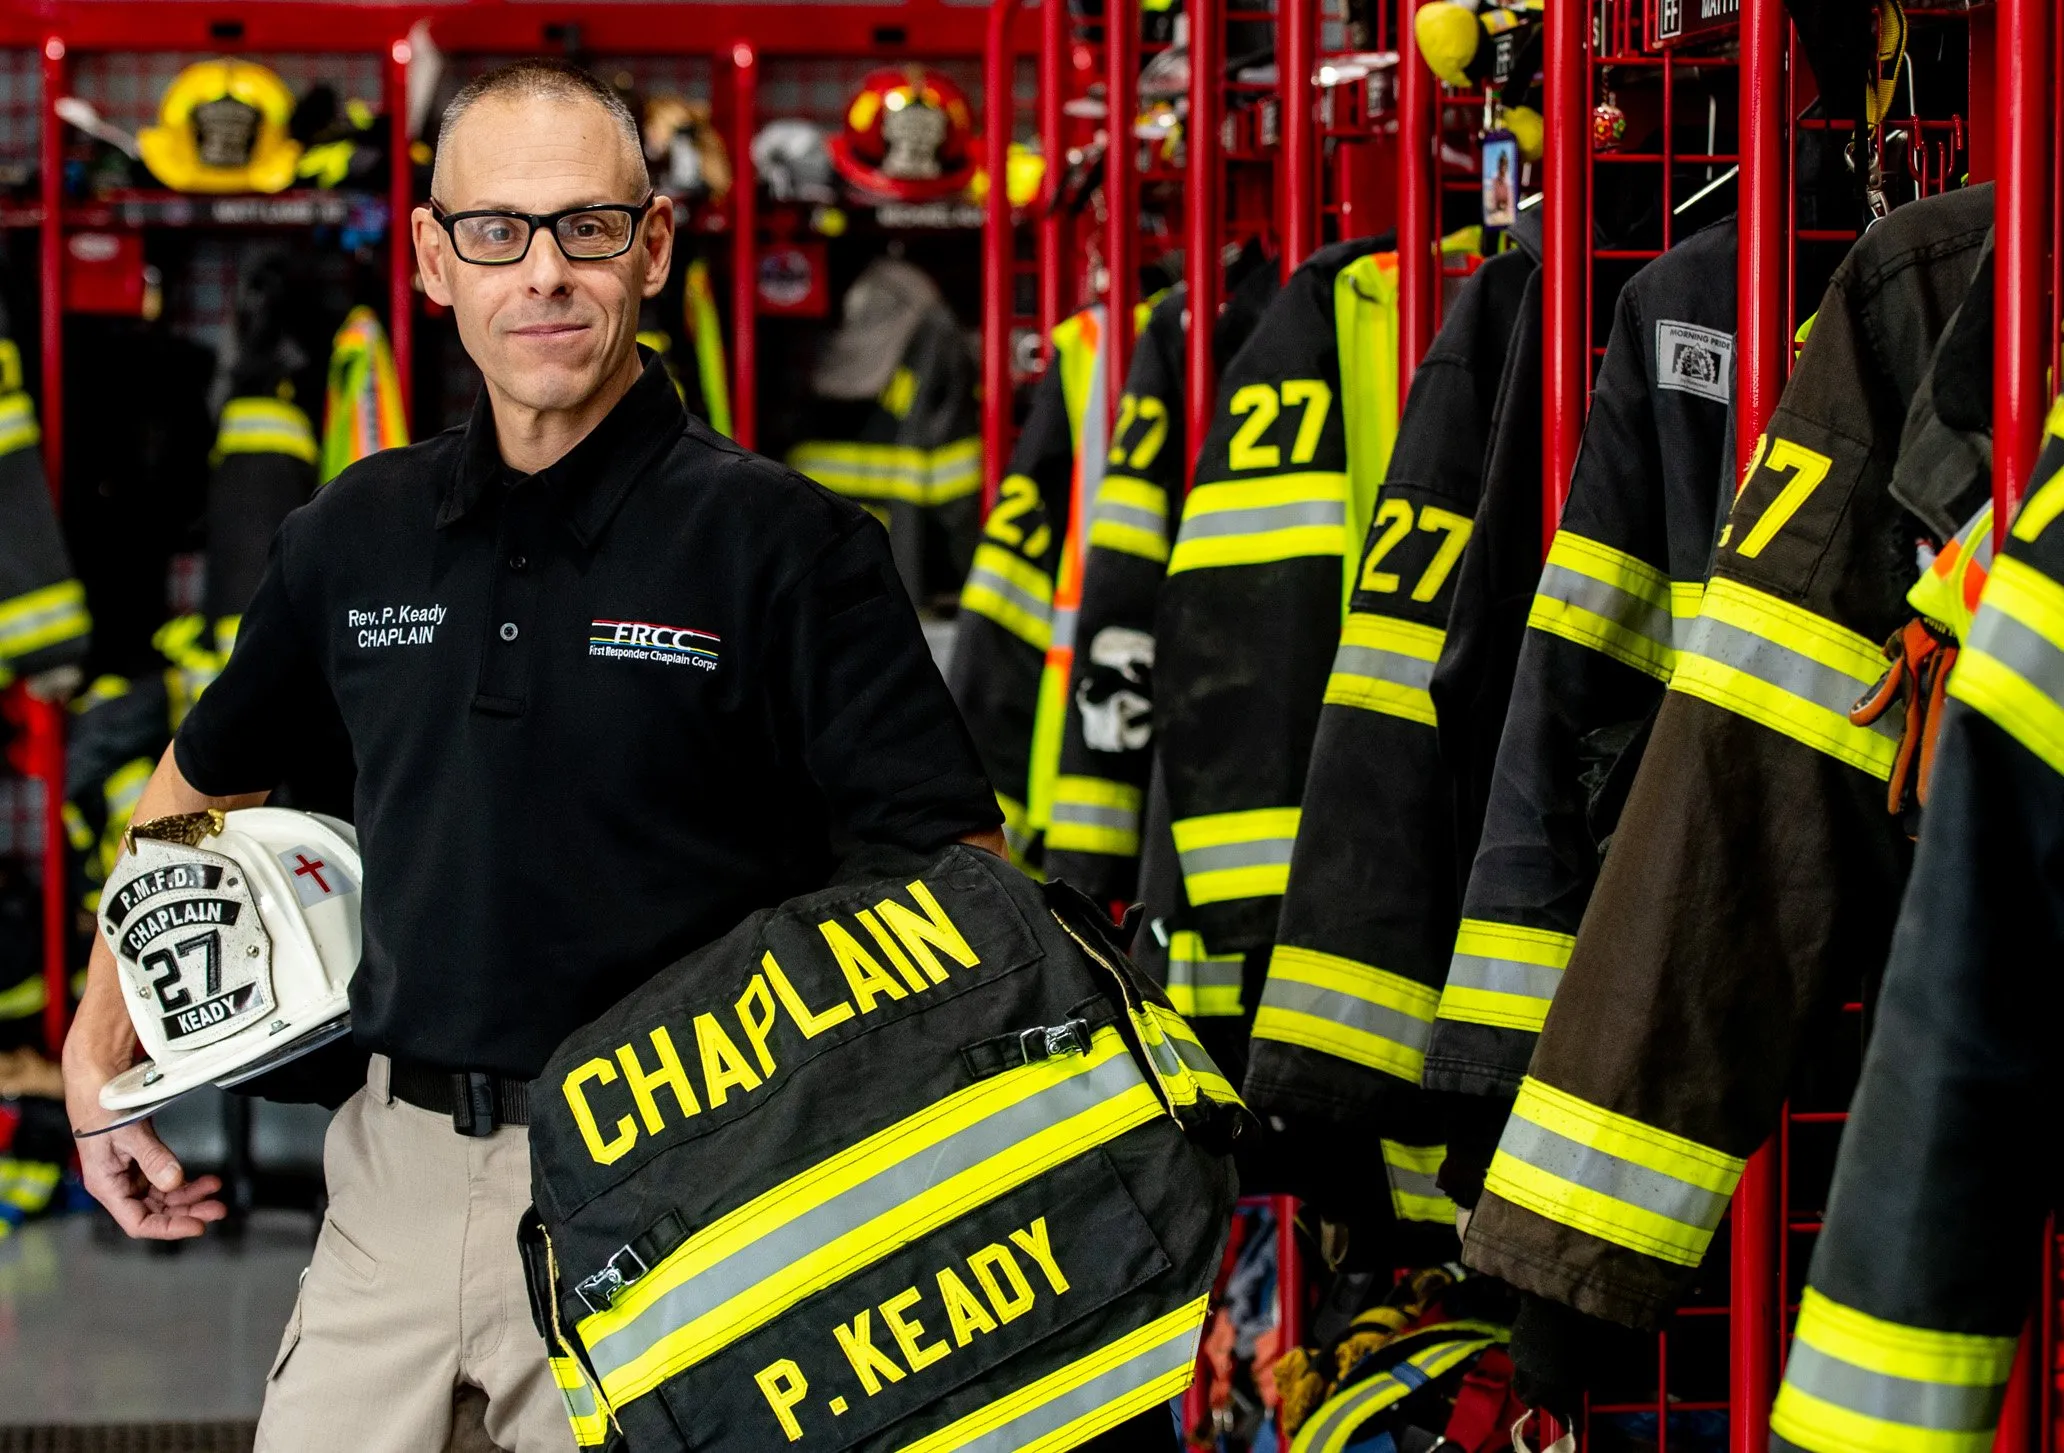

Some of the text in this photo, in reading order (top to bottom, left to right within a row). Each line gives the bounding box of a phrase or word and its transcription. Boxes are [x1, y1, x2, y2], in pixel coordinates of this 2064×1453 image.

[1670, 328, 1731, 350] MORNING PRIDE
[1229, 379, 1332, 471] 27
[1717, 433, 1833, 559] 7
[1359, 498, 1474, 602] 27
[348, 603, 447, 628] Rev. P. Keady
[357, 625, 434, 648] CHAPLAIN
[613, 622, 694, 651] FRCC
[589, 644, 718, 672] First Responder Chaplain Corps
[119, 867, 195, 911] P.M.F.D.
[128, 902, 222, 951] CHAPLAIN
[141, 928, 222, 1014] 27
[177, 995, 236, 1034] KEADY
[563, 879, 980, 1165] CHAPLAIN
[754, 1216, 1070, 1441] P. KEADY
